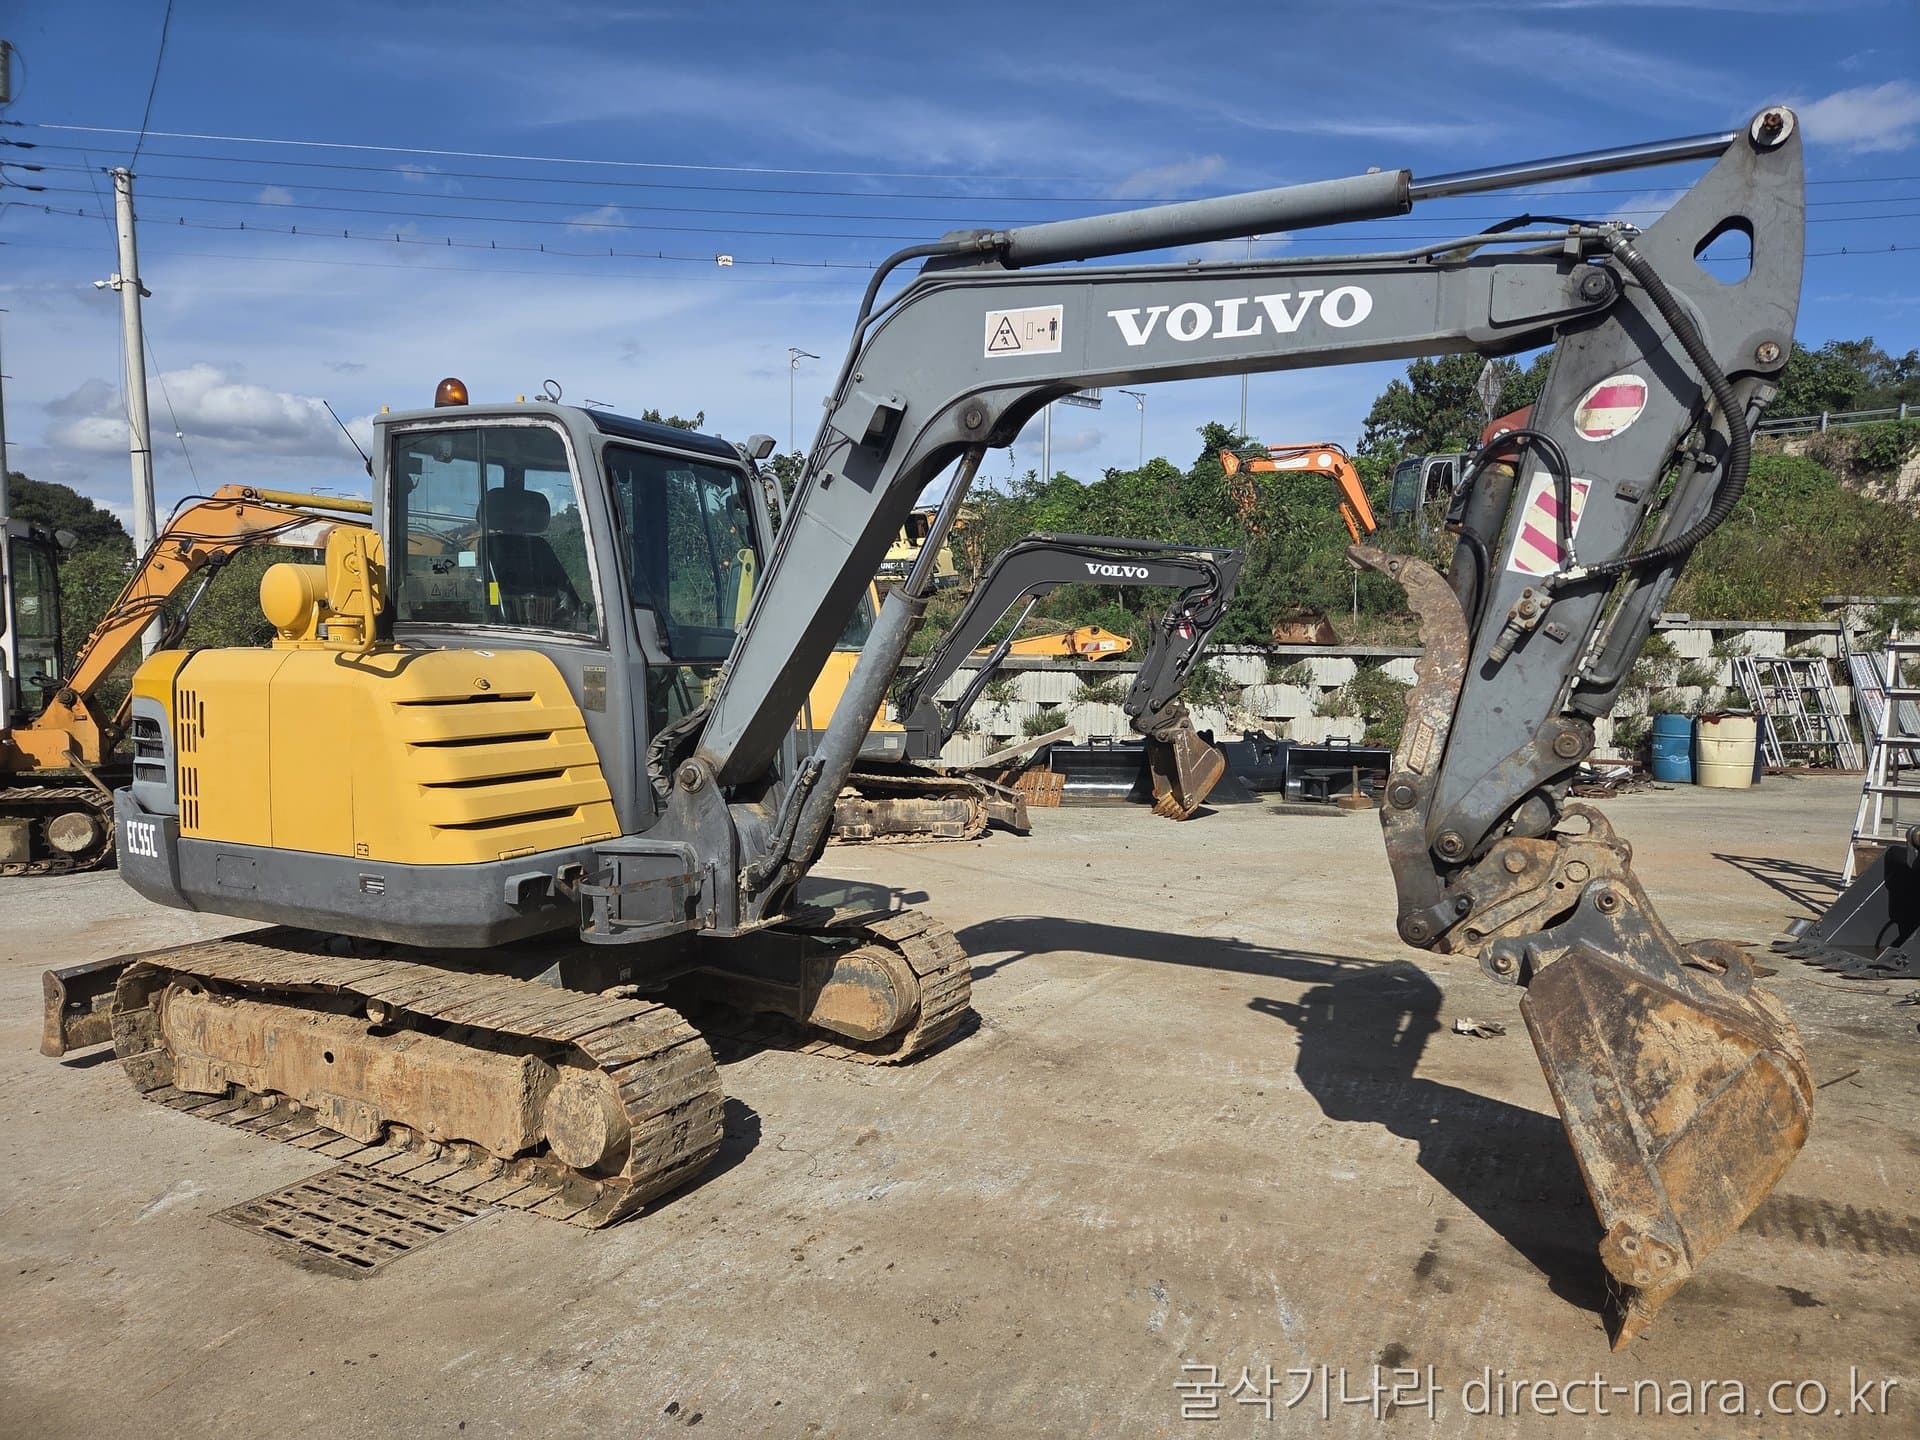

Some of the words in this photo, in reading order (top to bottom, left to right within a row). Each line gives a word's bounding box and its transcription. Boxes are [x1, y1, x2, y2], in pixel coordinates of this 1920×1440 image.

[1107, 285, 1374, 346] VOLVO
[1085, 562, 1149, 579] VOLVO
[127, 820, 158, 858] EC55C
